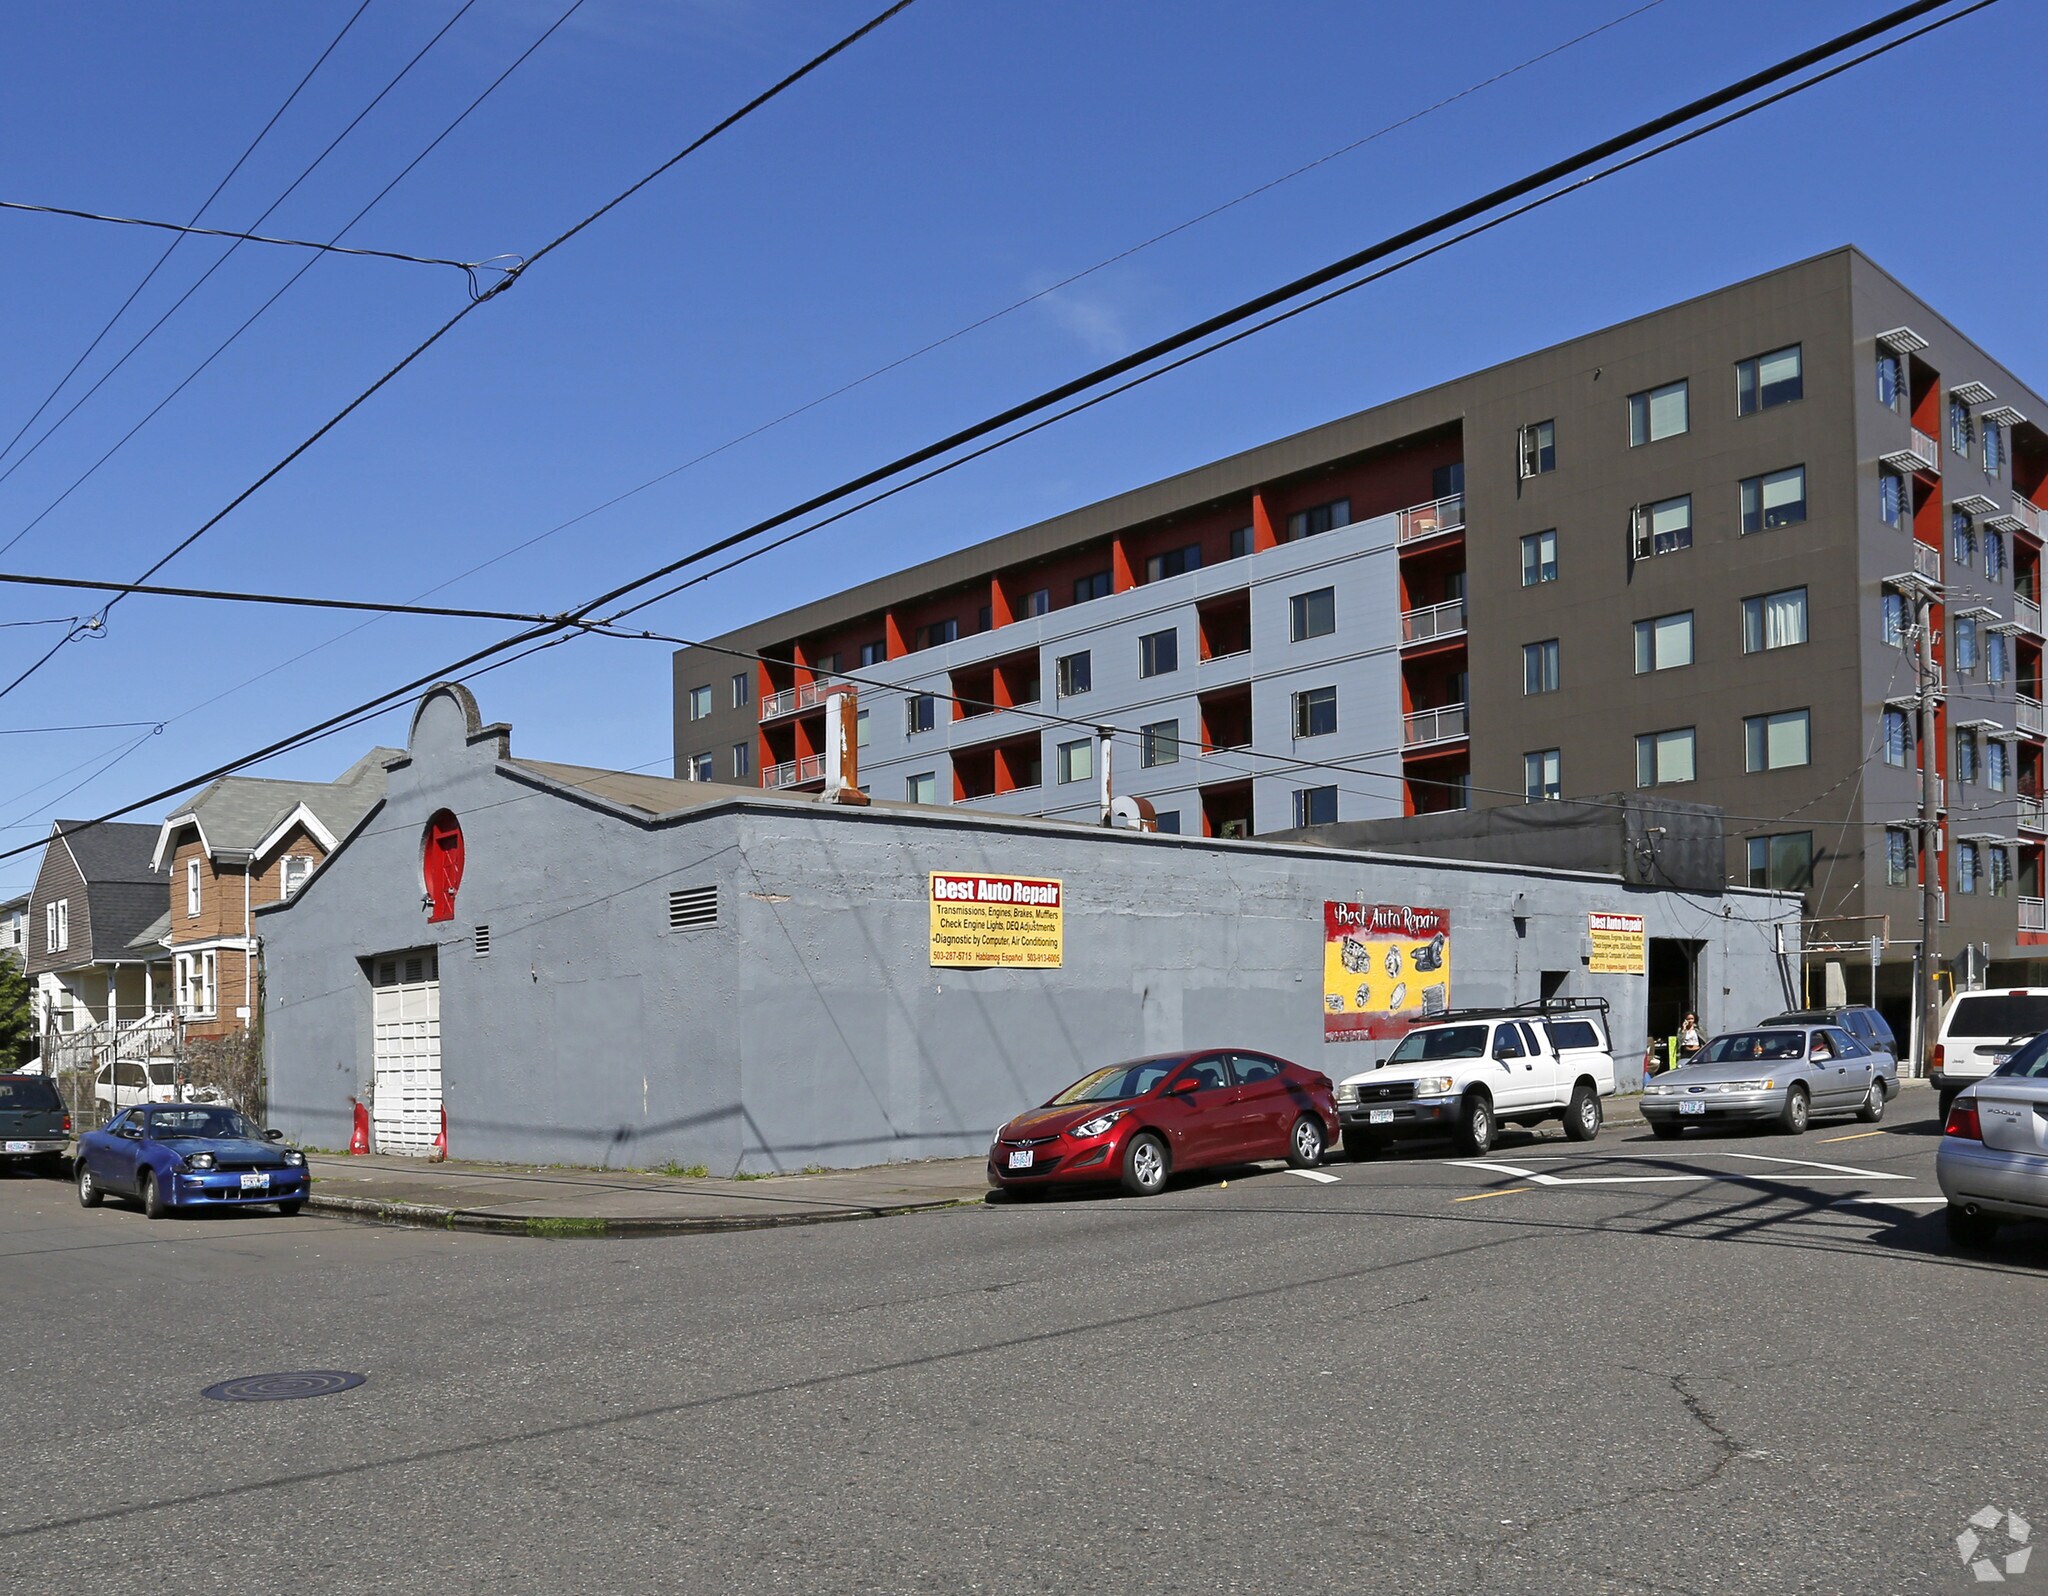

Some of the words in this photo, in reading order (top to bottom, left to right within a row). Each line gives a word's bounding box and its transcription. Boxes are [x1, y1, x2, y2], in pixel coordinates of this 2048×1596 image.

[935, 878, 974, 899] Best
[977, 880, 1012, 902] Auto
[1012, 882, 1058, 905] Repair
[937, 905, 987, 917] Transmissions,
[988, 906, 1012, 919] Engines,
[1013, 908, 1035, 919] Brakes,
[1035, 909, 1058, 920] Mufflers
[1334, 903, 1366, 926] Best
[1367, 908, 1400, 933] Auto
[1401, 906, 1440, 933] Repair
[940, 918, 961, 929] Check
[963, 919, 985, 931] Engine
[986, 920, 1005, 932] Lights,
[1006, 921, 1019, 931] DEQ
[1020, 922, 1055, 933] Adjustments
[1591, 915, 1606, 929] Best
[1606, 916, 1621, 930] Auto
[1621, 917, 1642, 932] Repair
[973, 935, 980, 947] by
[981, 935, 1011, 947] Computer,
[1011, 936, 1020, 946] Air
[1021, 936, 1058, 949] Conditioning
[933, 951, 972, 961] 503-287-5715
[975, 952, 1001, 961] Hablamos
[1002, 952, 1023, 963] Español
[1027, 953, 1060, 963] 503-913-6005
